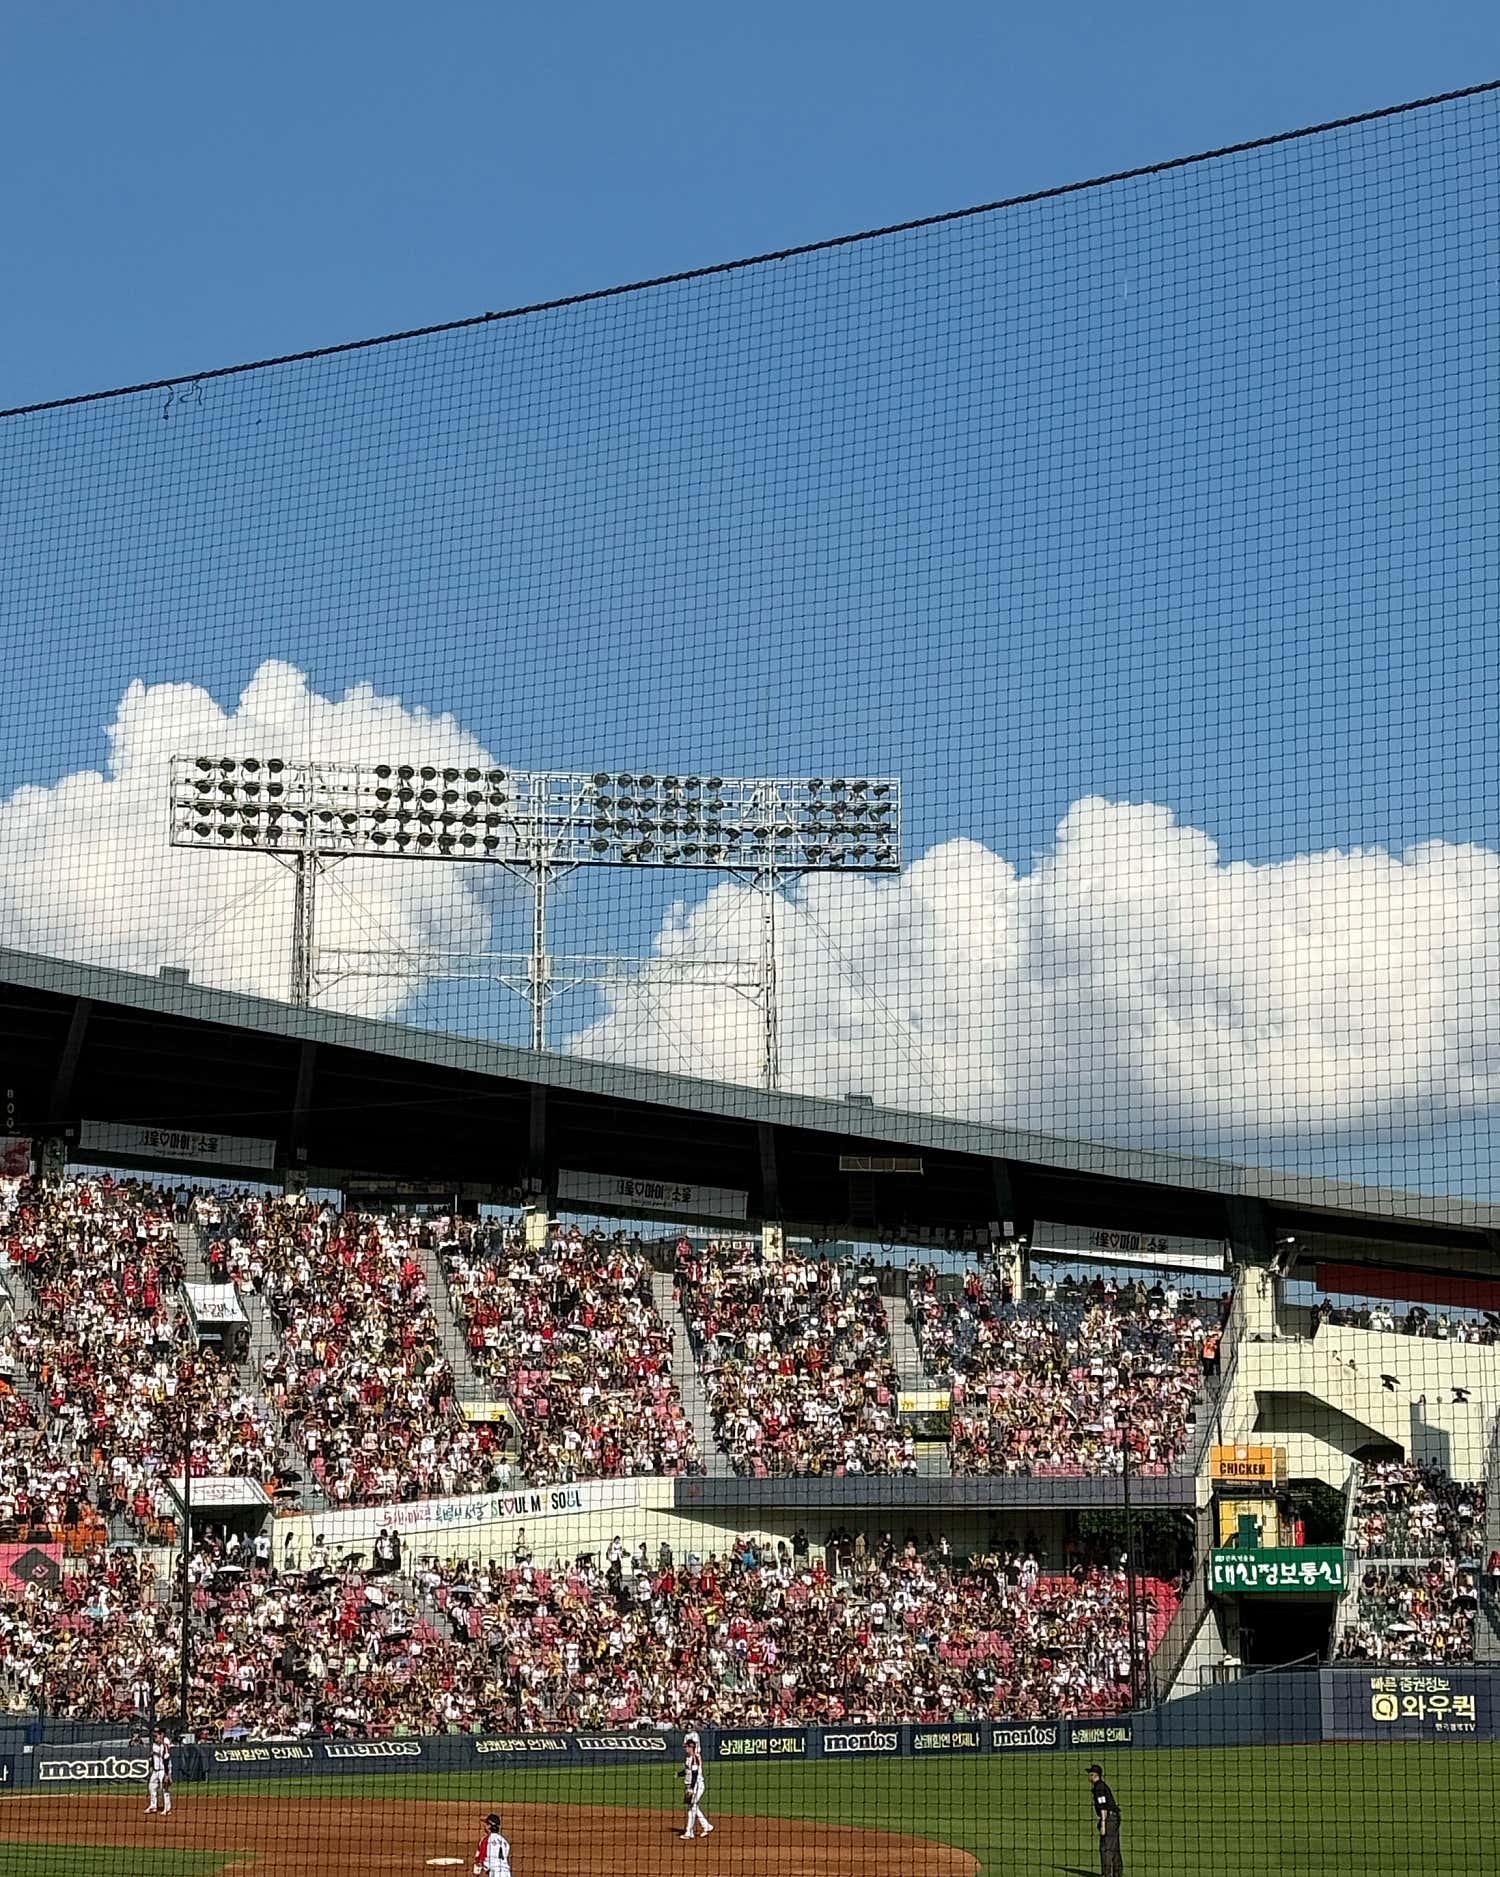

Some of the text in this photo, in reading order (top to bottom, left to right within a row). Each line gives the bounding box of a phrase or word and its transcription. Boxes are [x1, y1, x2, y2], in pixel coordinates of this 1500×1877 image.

[1220, 1463, 1266, 1475] CHICKEN
[551, 1489, 582, 1510] SOUL
[1214, 1561, 1342, 1586] 대신정보통신
[1371, 1676, 1451, 1693] 빠른 증권정보
[1402, 1695, 1475, 1721] 와우퀵
[576, 1736, 666, 1751] mentos
[824, 1731, 898, 1752] mentos
[951, 1731, 979, 1748] 언제나
[993, 1726, 1057, 1747] mentos
[1106, 1727, 1132, 1743] 언제나
[324, 1741, 421, 1758] mentos
[527, 1737, 567, 1751] 언제나
[769, 1737, 805, 1754] 언제나
[271, 1746, 313, 1760] 언제나
[40, 1756, 150, 1780] mentos
